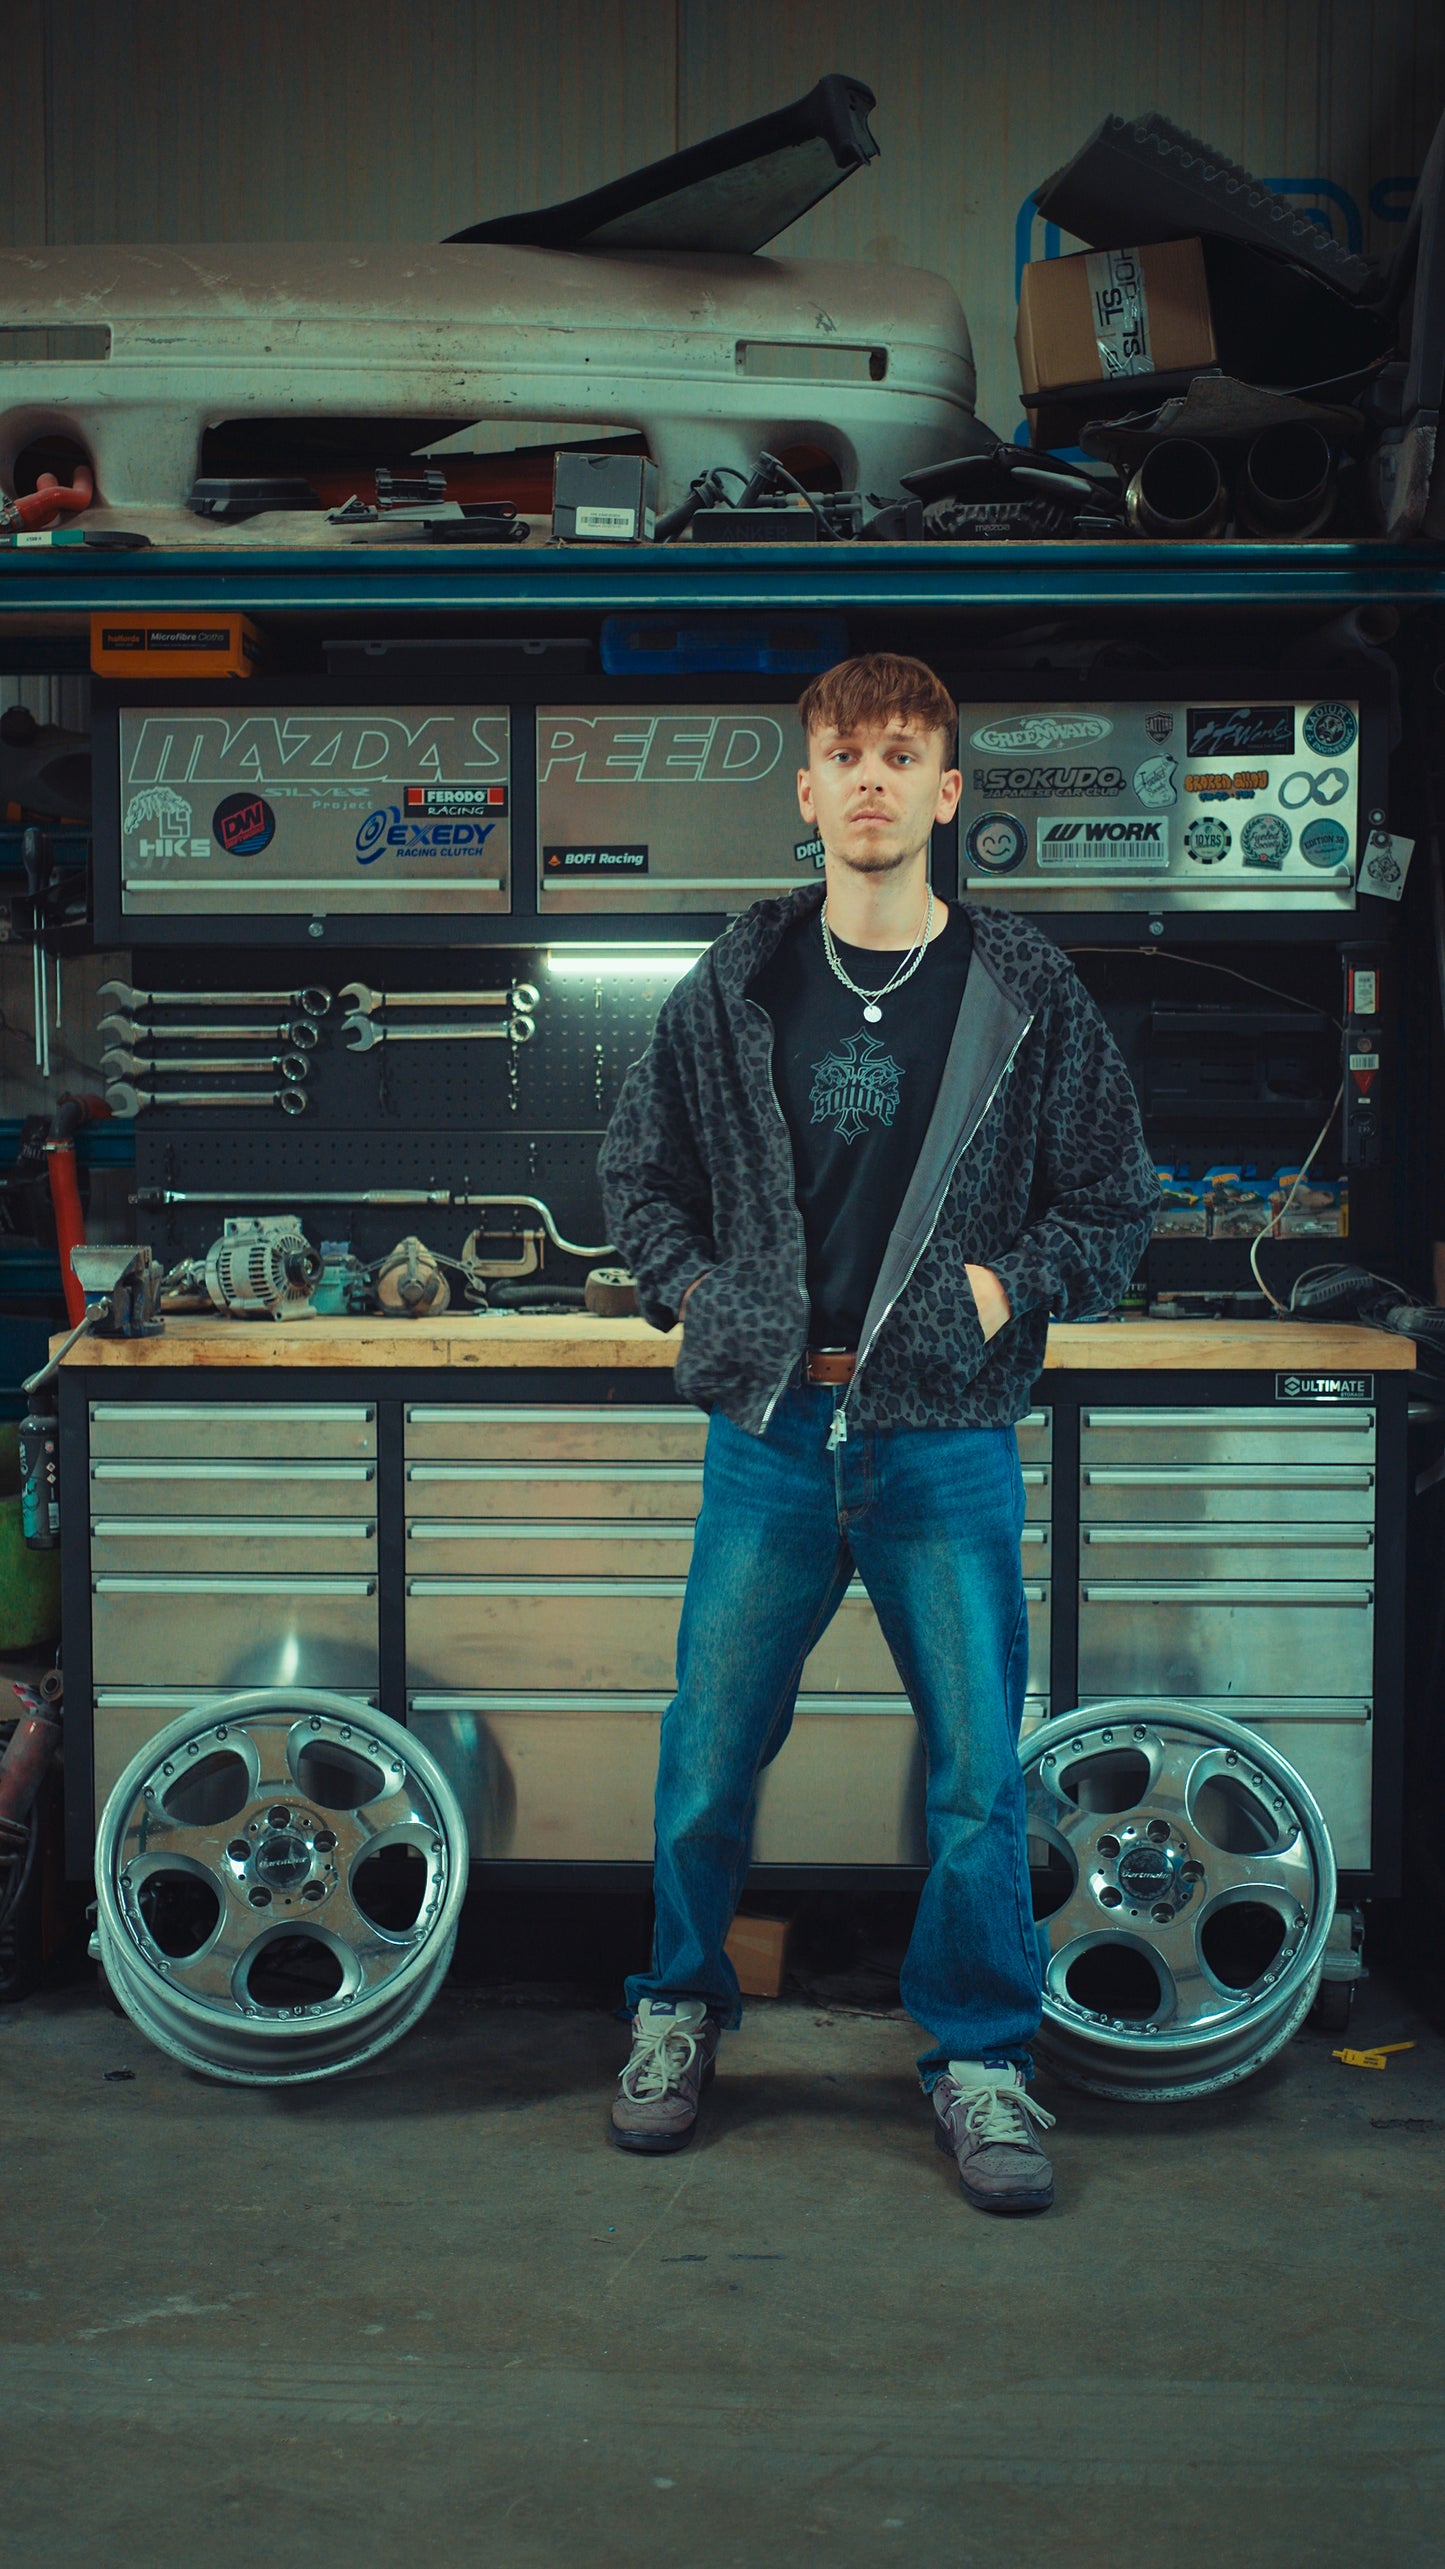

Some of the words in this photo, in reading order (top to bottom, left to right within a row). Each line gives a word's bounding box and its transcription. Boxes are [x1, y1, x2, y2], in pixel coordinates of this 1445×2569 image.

[151, 632, 197, 641] Microfibre
[198, 632, 225, 641] Cloths
[1305, 704, 1348, 731] RADIUM
[982, 719, 1101, 749] GREENWAYS
[260, 787, 371, 797] SILVER
[427, 791, 486, 803] FERODO
[983, 788, 1052, 799] JAPANESE
[1054, 788, 1083, 797] CAR
[1085, 787, 1120, 797] CLUB
[312, 800, 373, 811] Project
[427, 805, 485, 816] RACING
[386, 823, 496, 846] EXEDY
[1084, 822, 1162, 841] WORK
[139, 838, 211, 858] HKS
[1304, 835, 1334, 849] EDITION
[396, 848, 437, 857] RACING
[440, 847, 483, 857] CLUTCH
[796, 840, 825, 860] DRI
[564, 853, 596, 865] BOFI
[599, 852, 644, 866] Racing
[1301, 1379, 1366, 1392] ULTIMATE
